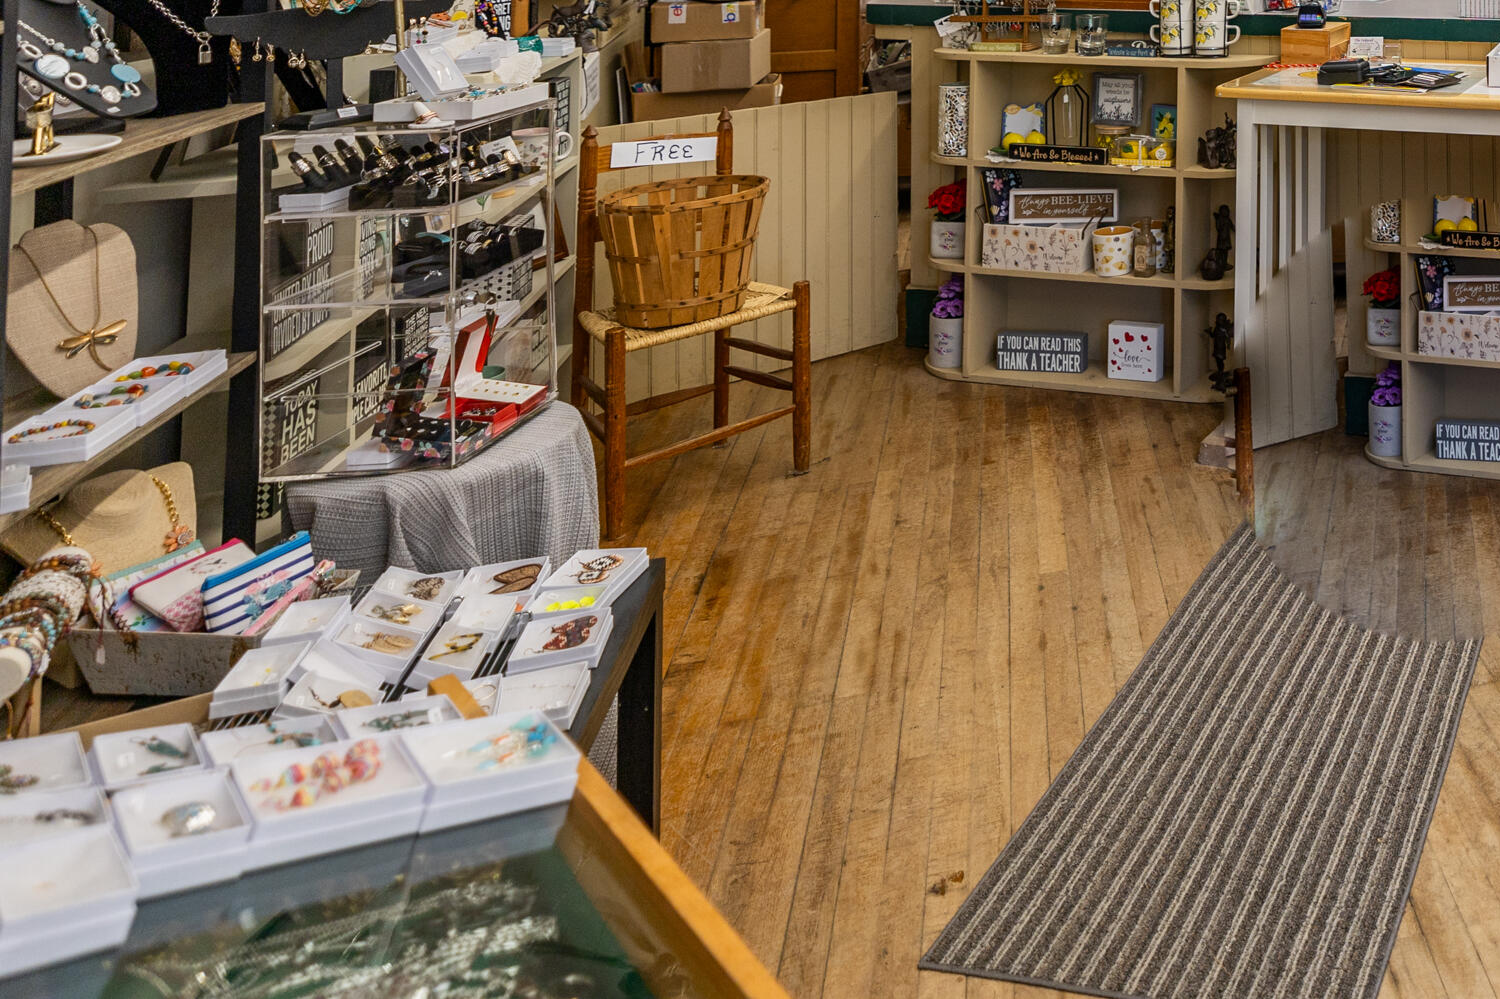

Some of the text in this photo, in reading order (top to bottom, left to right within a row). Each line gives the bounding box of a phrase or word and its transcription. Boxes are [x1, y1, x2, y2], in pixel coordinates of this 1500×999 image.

[634, 141, 694, 163] FREE
[1019, 148, 1094, 162] We Are So Blessed
[1051, 194, 1113, 205] BEE-LIEVE
[306, 223, 334, 268] PROUD
[1451, 234, 1465, 246] We
[1466, 234, 1480, 246] Are
[1482, 235, 1492, 246] So
[272, 313, 302, 355] DIVIDED
[998, 335, 1082, 352] IF YOU CAN READ THIS
[997, 351, 1081, 373] THANK A TEACHER
[284, 380, 318, 417] TODAY
[282, 399, 317, 444] HAS
[1436, 424, 1443, 438] IF
[1445, 424, 1460, 439] YOU
[1462, 425, 1478, 439] CAN
[1479, 426, 1500, 440] READ
[281, 428, 316, 465] BEEN
[1437, 440, 1468, 460] THANK
[1469, 443, 1478, 460] A
